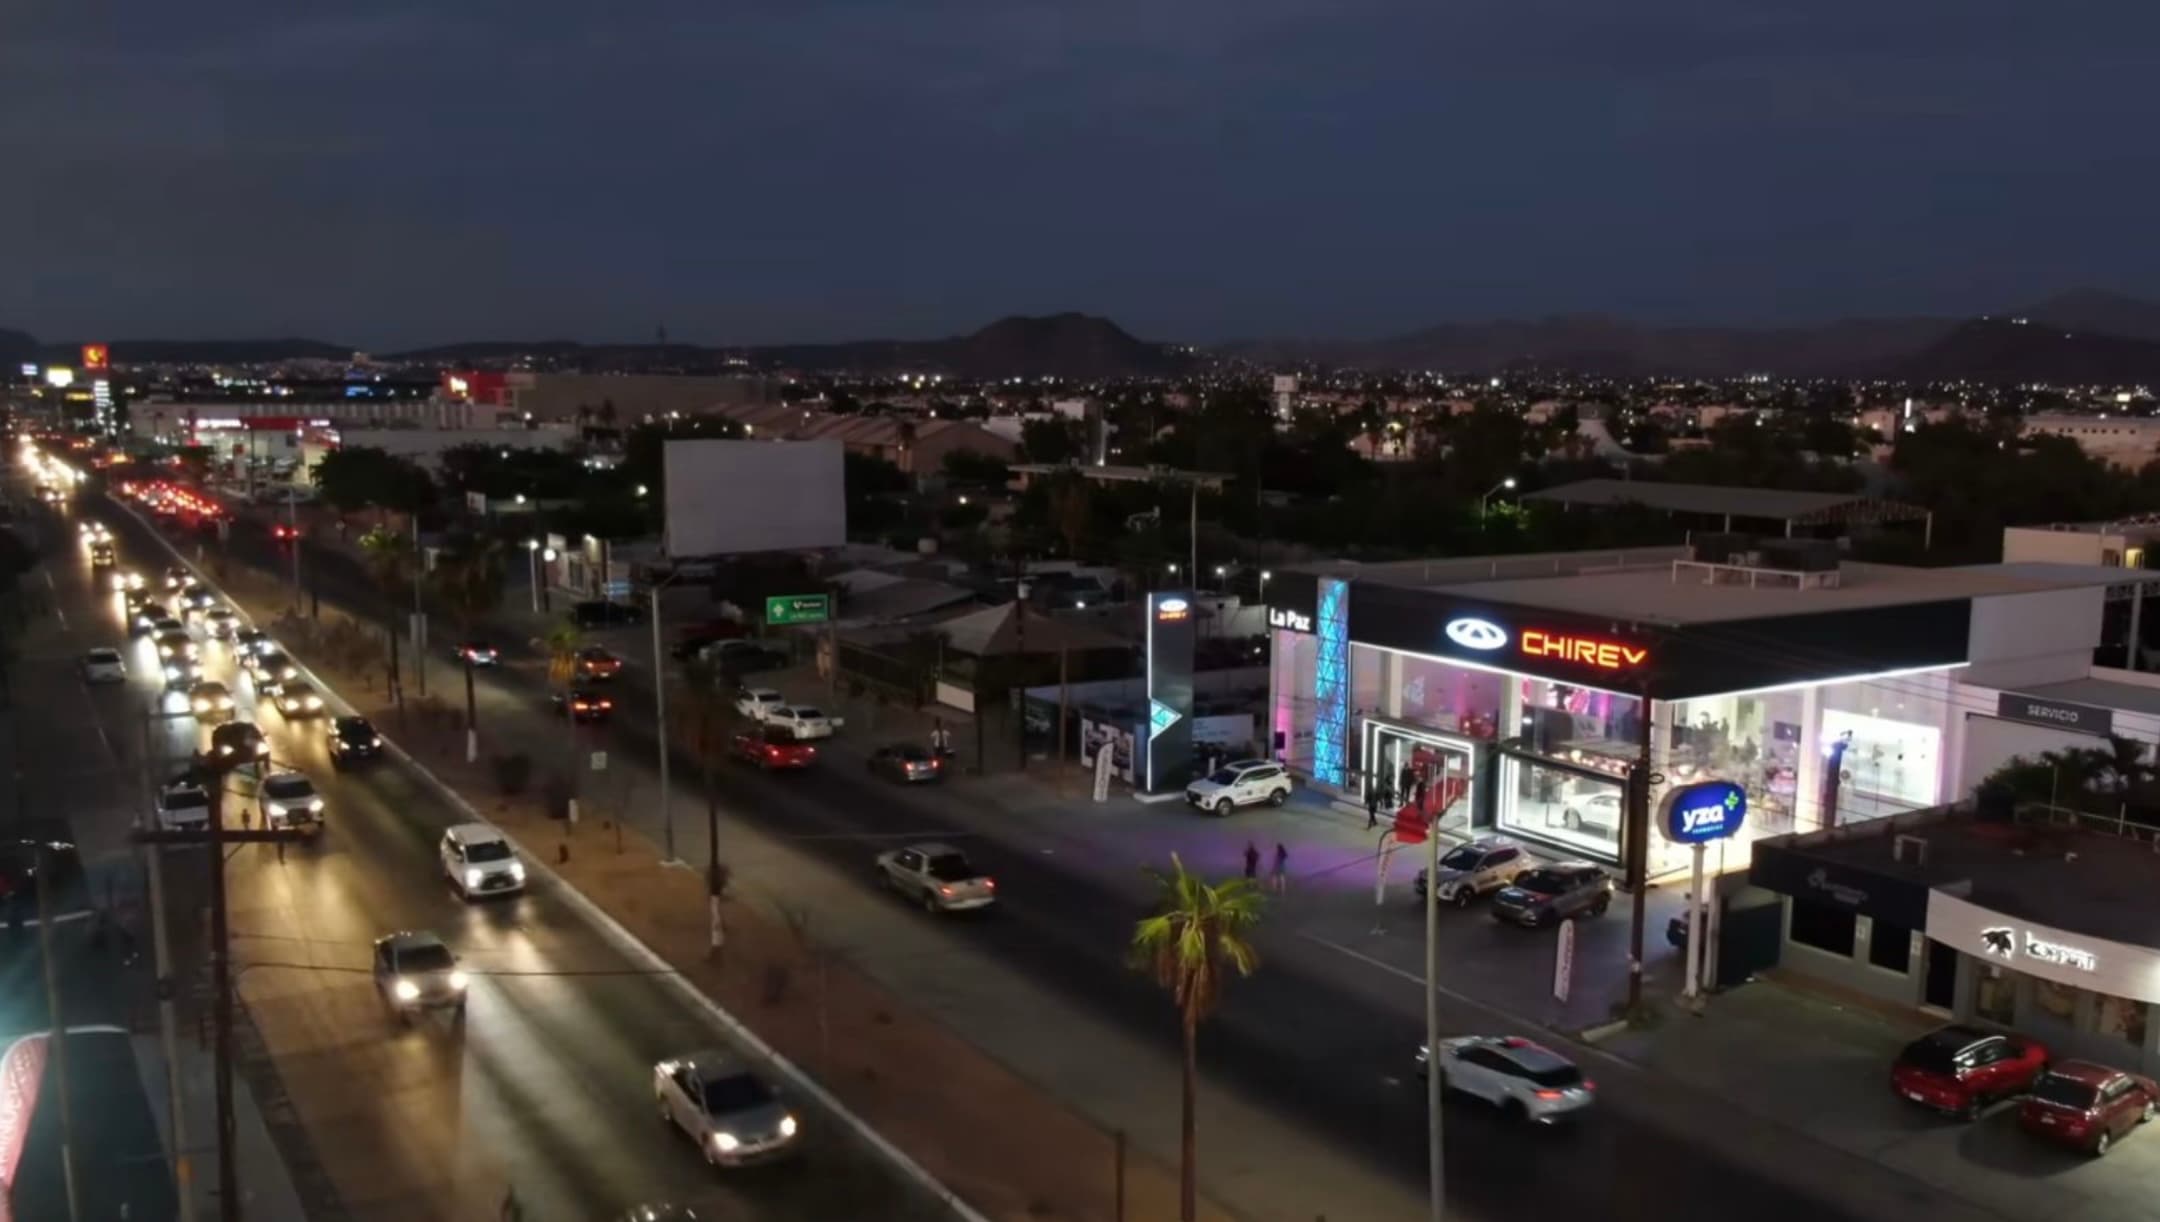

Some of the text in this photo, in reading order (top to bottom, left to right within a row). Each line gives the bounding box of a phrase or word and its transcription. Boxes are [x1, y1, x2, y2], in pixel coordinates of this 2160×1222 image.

[1269, 607, 1311, 632] La Paz
[2027, 704, 2079, 723] SERVICIO
[1682, 804, 1725, 833] yza
